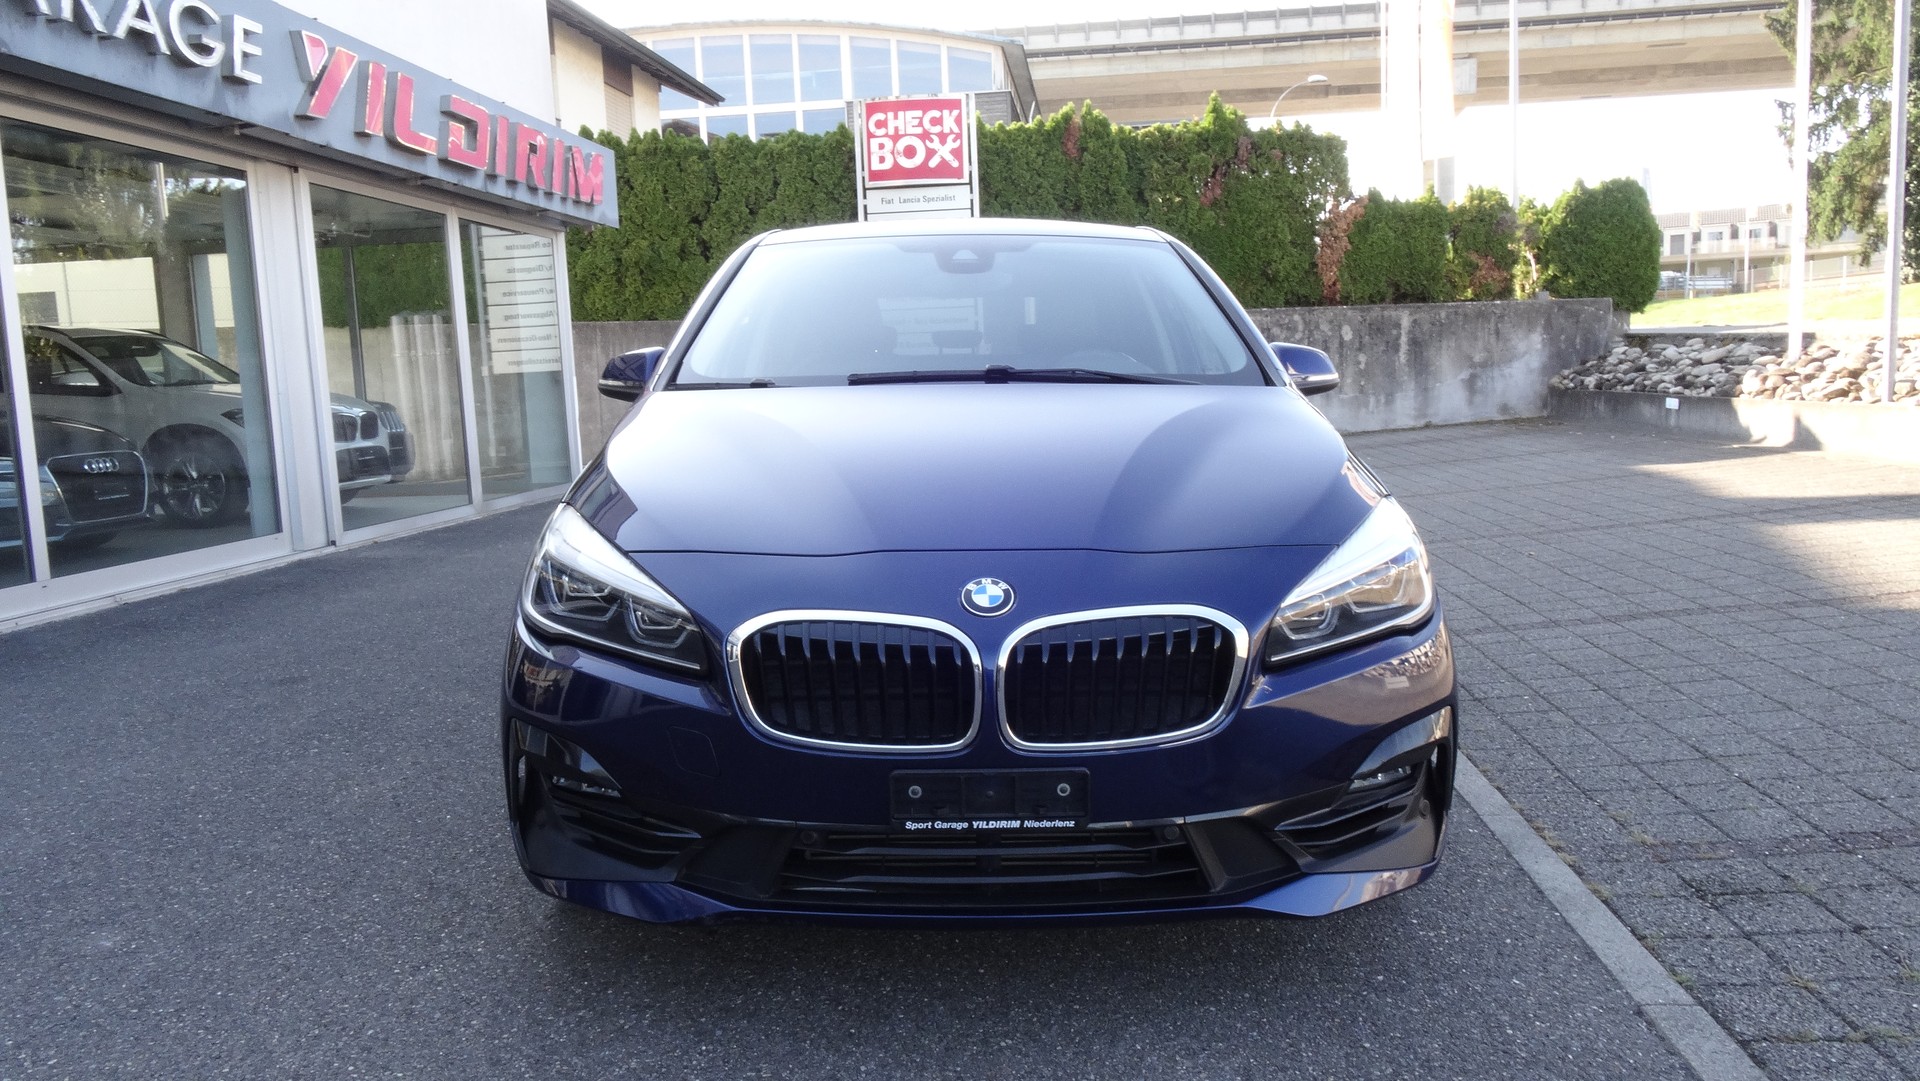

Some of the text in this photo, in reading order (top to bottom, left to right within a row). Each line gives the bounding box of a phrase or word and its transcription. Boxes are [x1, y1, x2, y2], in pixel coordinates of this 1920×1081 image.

[290, 30, 604, 205] YILDIRIM
[868, 109, 961, 136] CHECK
[880, 194, 956, 205] Fiat Lancia Spezialist
[905, 819, 1076, 831] Sport Garage YILDIRIM Niederlenz
